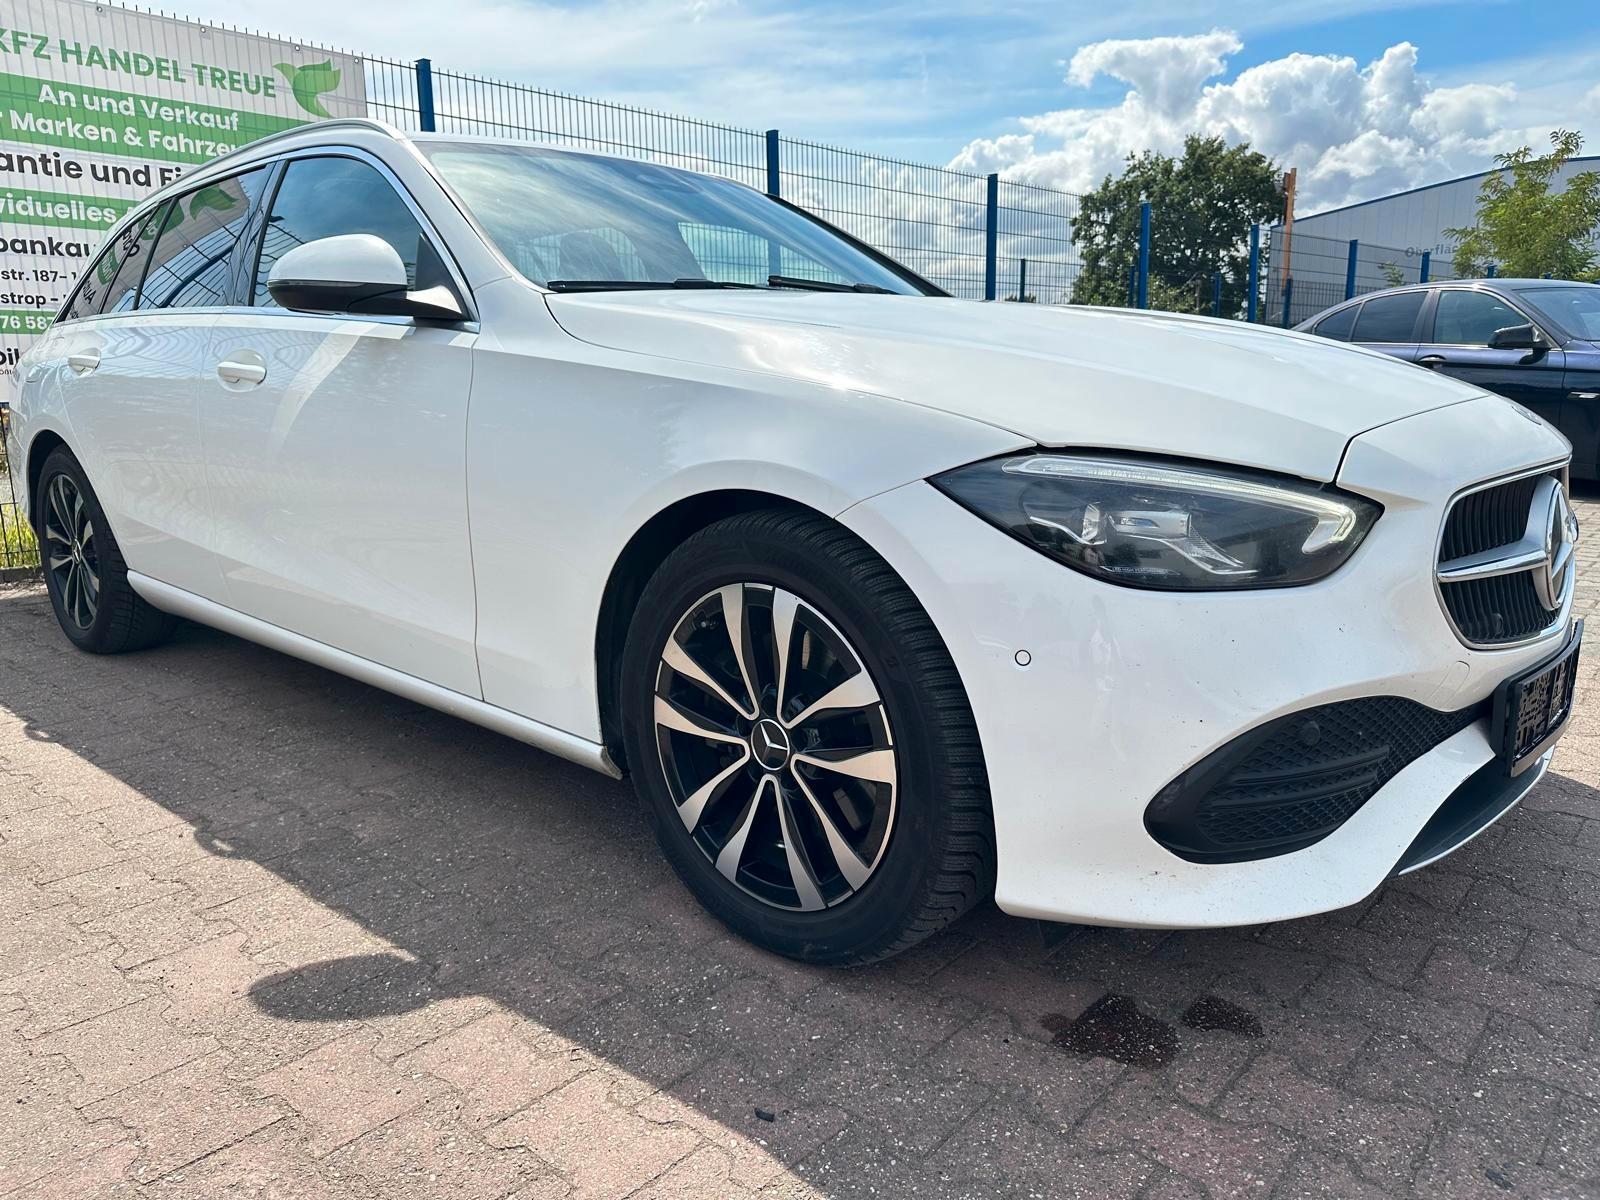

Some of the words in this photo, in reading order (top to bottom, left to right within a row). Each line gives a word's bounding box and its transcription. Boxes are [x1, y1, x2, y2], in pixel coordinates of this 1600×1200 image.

[59, 39, 186, 83] HANDEL
[191, 63, 276, 98] TREUE
[10, 110, 117, 143] Marken
[123, 127, 144, 146] &
[39, 84, 76, 107] An
[83, 93, 136, 116] und
[140, 99, 238, 131] Verkauf
[90, 161, 151, 187] und
